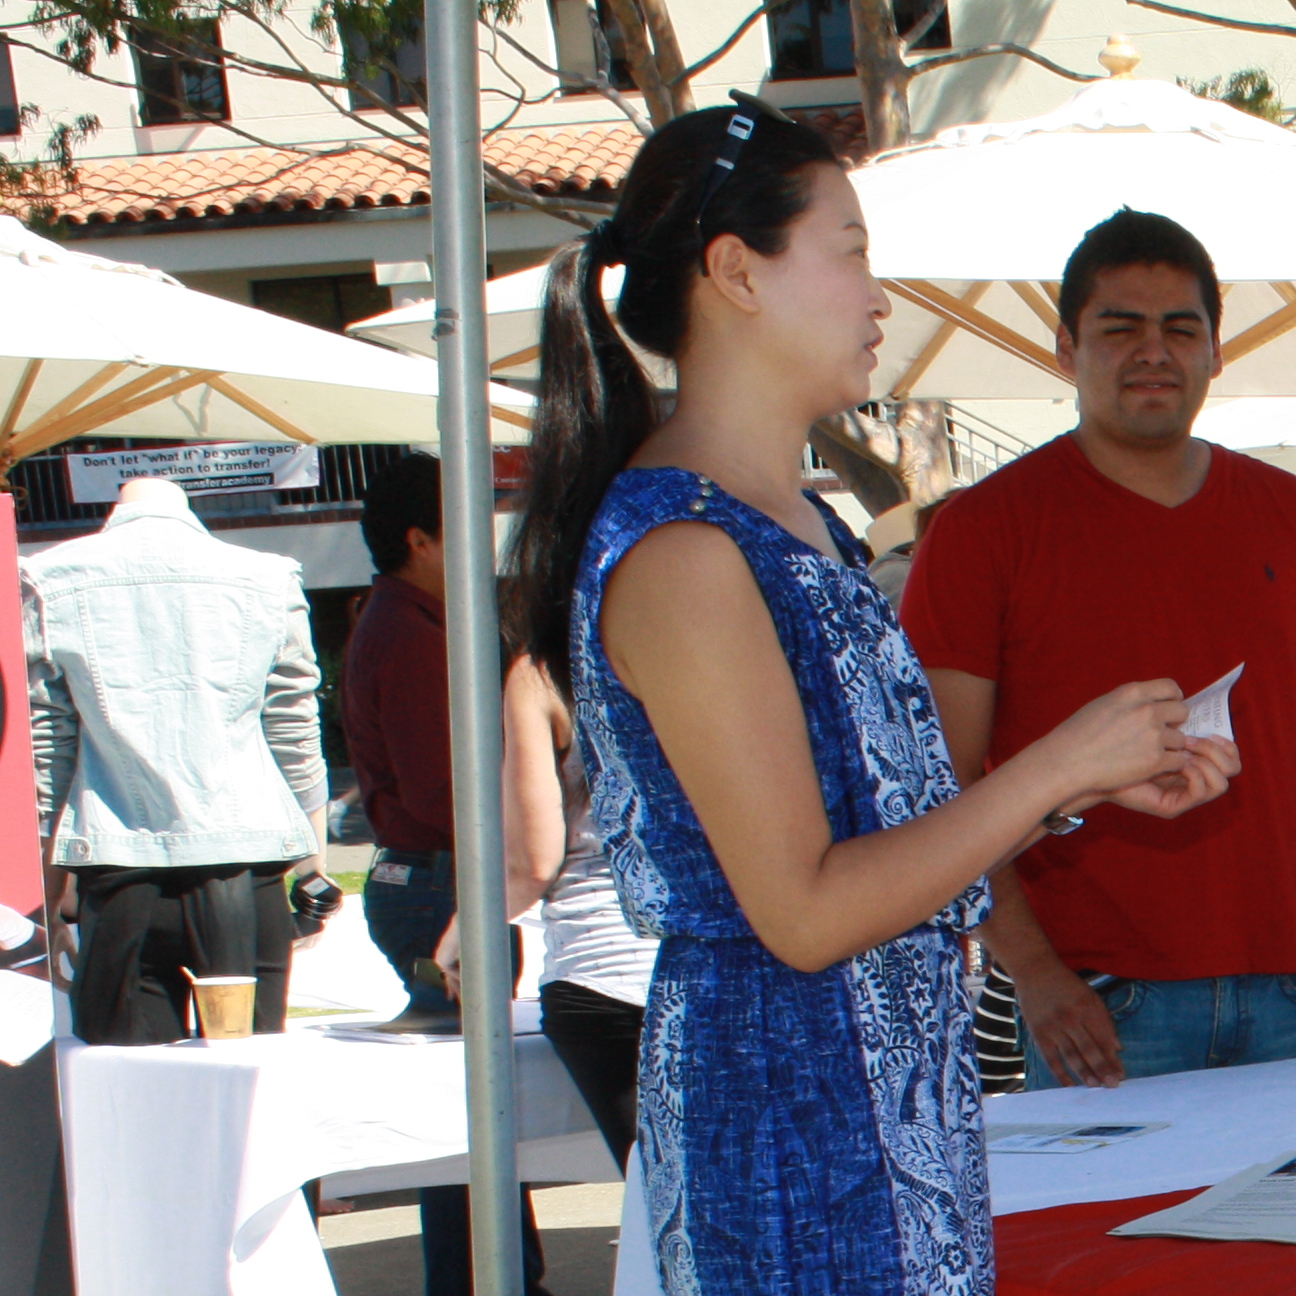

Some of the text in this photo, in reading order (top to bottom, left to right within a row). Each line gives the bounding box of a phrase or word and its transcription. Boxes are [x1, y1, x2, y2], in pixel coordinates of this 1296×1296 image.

[121, 454, 139, 466] let
[203, 449, 219, 460] be
[222, 447, 252, 460] your
[120, 458, 271, 479] take action to transfer!
